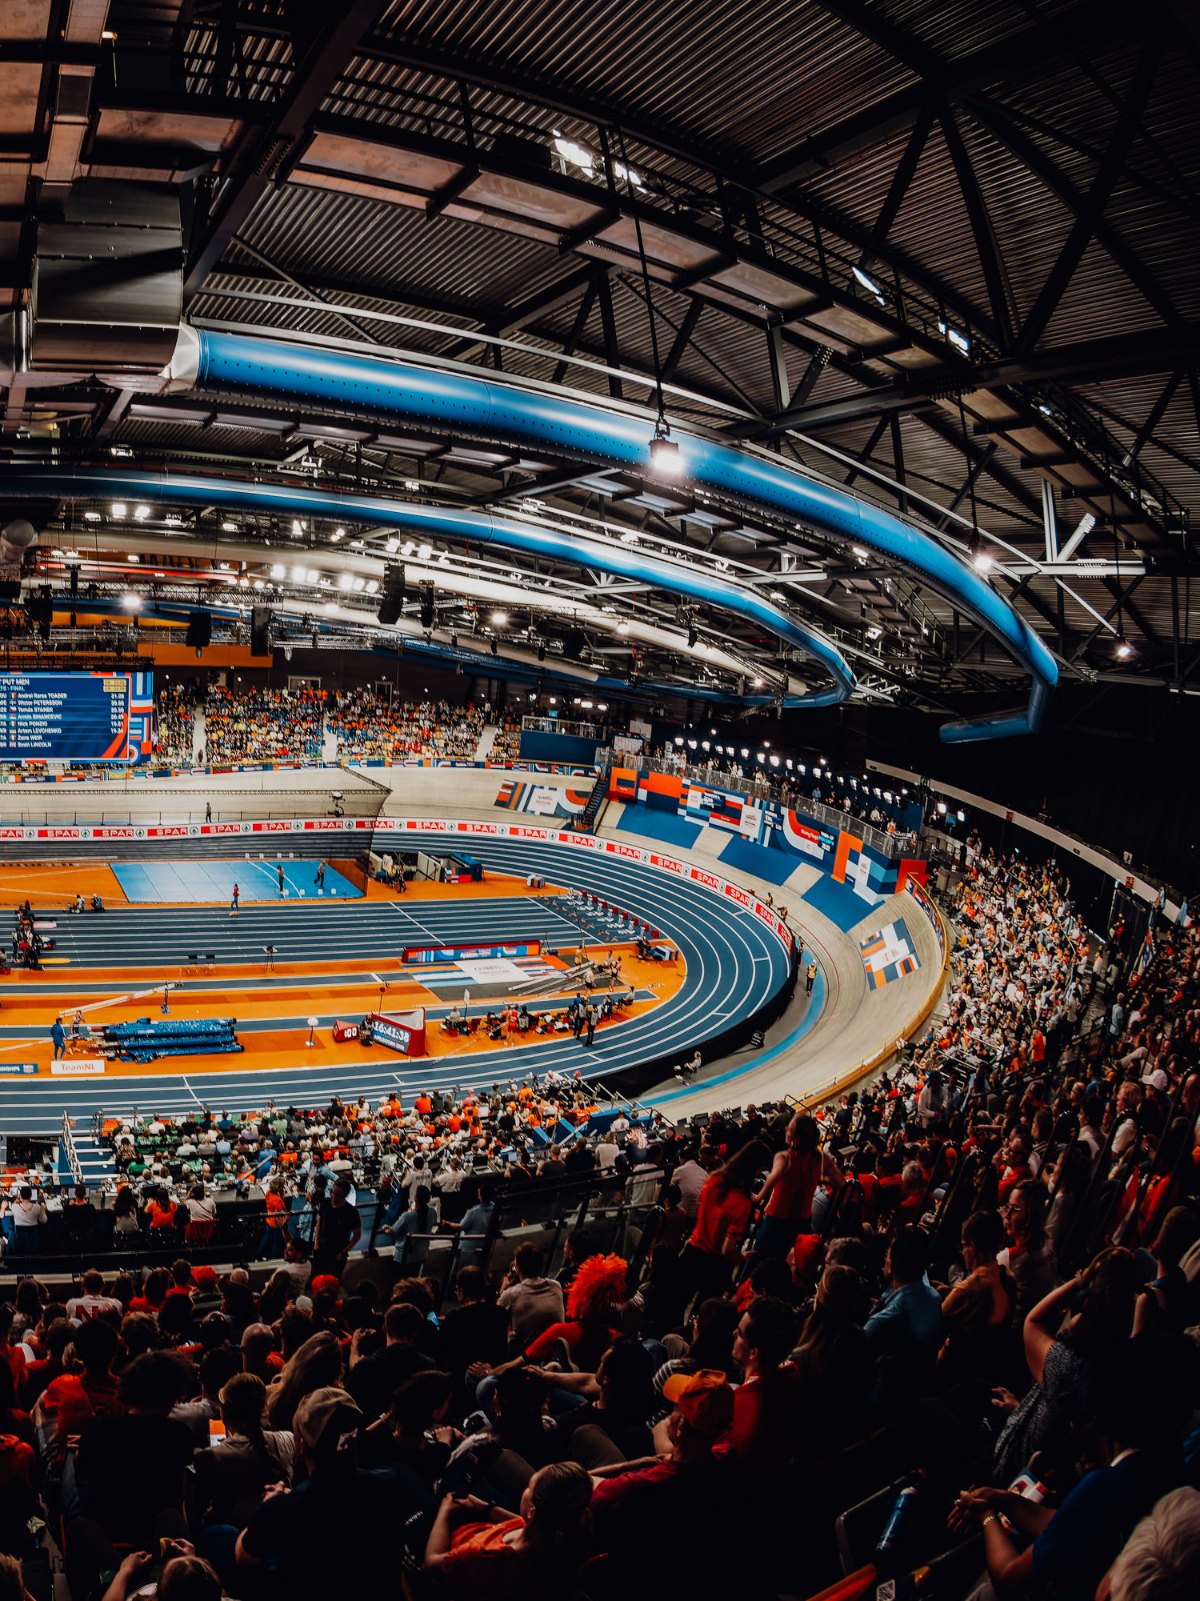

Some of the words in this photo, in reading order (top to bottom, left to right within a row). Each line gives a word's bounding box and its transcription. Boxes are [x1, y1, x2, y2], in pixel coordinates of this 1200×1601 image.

[262, 823, 291, 832] SPAR
[313, 821, 343, 830] SPAR
[364, 820, 394, 829] SPAR
[416, 821, 446, 830] SPAR
[467, 824, 497, 834] SPAR
[47, 830, 79, 838] SPAR
[102, 829, 134, 838] SPAR
[157, 828, 188, 836] SPAR
[210, 825, 240, 834] SPAR
[518, 828, 548, 839] SPAR
[567, 836, 596, 848] SPAR
[614, 845, 641, 859] SPAR
[657, 857, 683, 873] SPAR
[697, 873, 719, 890] SPAR
[730, 888, 750, 906] SPAR
[759, 908, 774, 927] SPAR
[373, 1020, 410, 1043] 16:41:38
[62, 1062, 96, 1071] TeamNL
